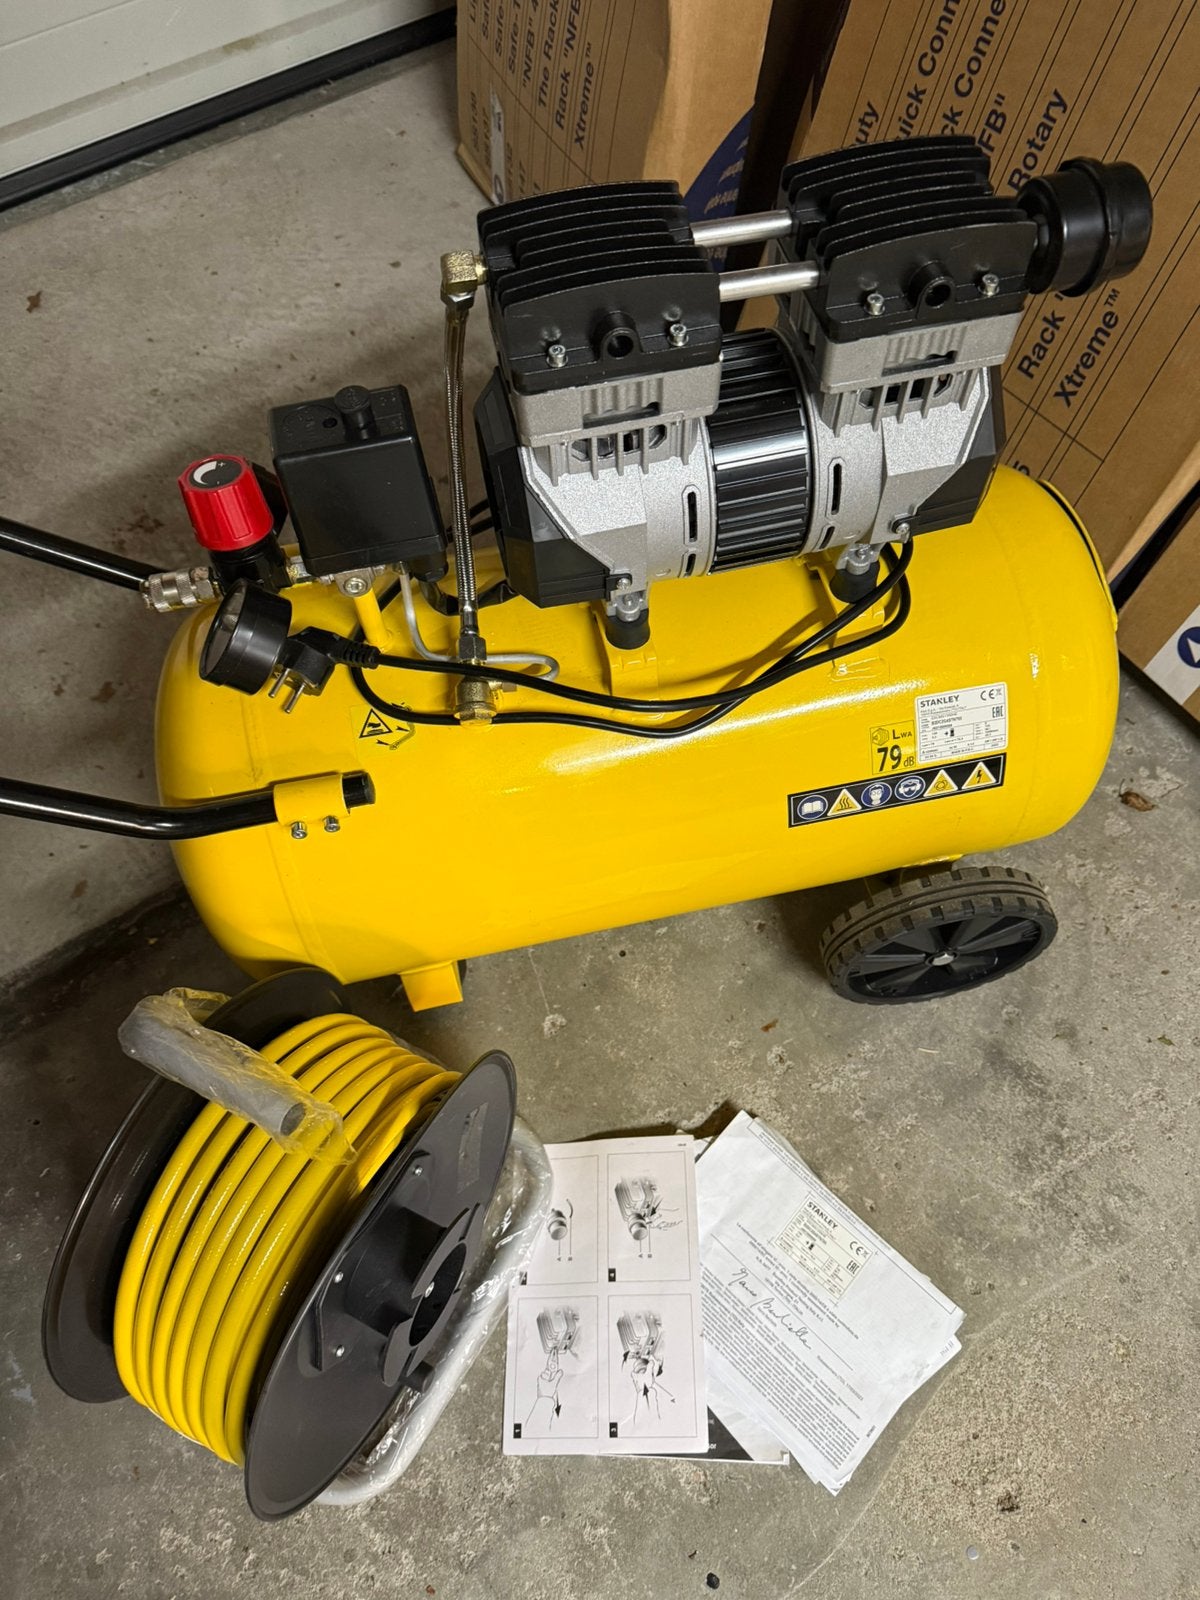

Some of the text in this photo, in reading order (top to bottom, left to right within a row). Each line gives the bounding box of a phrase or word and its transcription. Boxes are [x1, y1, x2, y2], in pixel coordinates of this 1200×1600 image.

[538, 0, 559, 109] The Rack
[555, 68, 571, 130] Rack
[854, 101, 880, 145] uty
[977, 92, 1007, 157] FB"
[1007, 88, 1069, 193] Rotary
[1017, 310, 1066, 380] Rack
[919, 694, 960, 708] STANLEY
[877, 744, 902, 772] 79
[903, 755, 915, 768] dB
[806, 1201, 838, 1229] STANLEY
